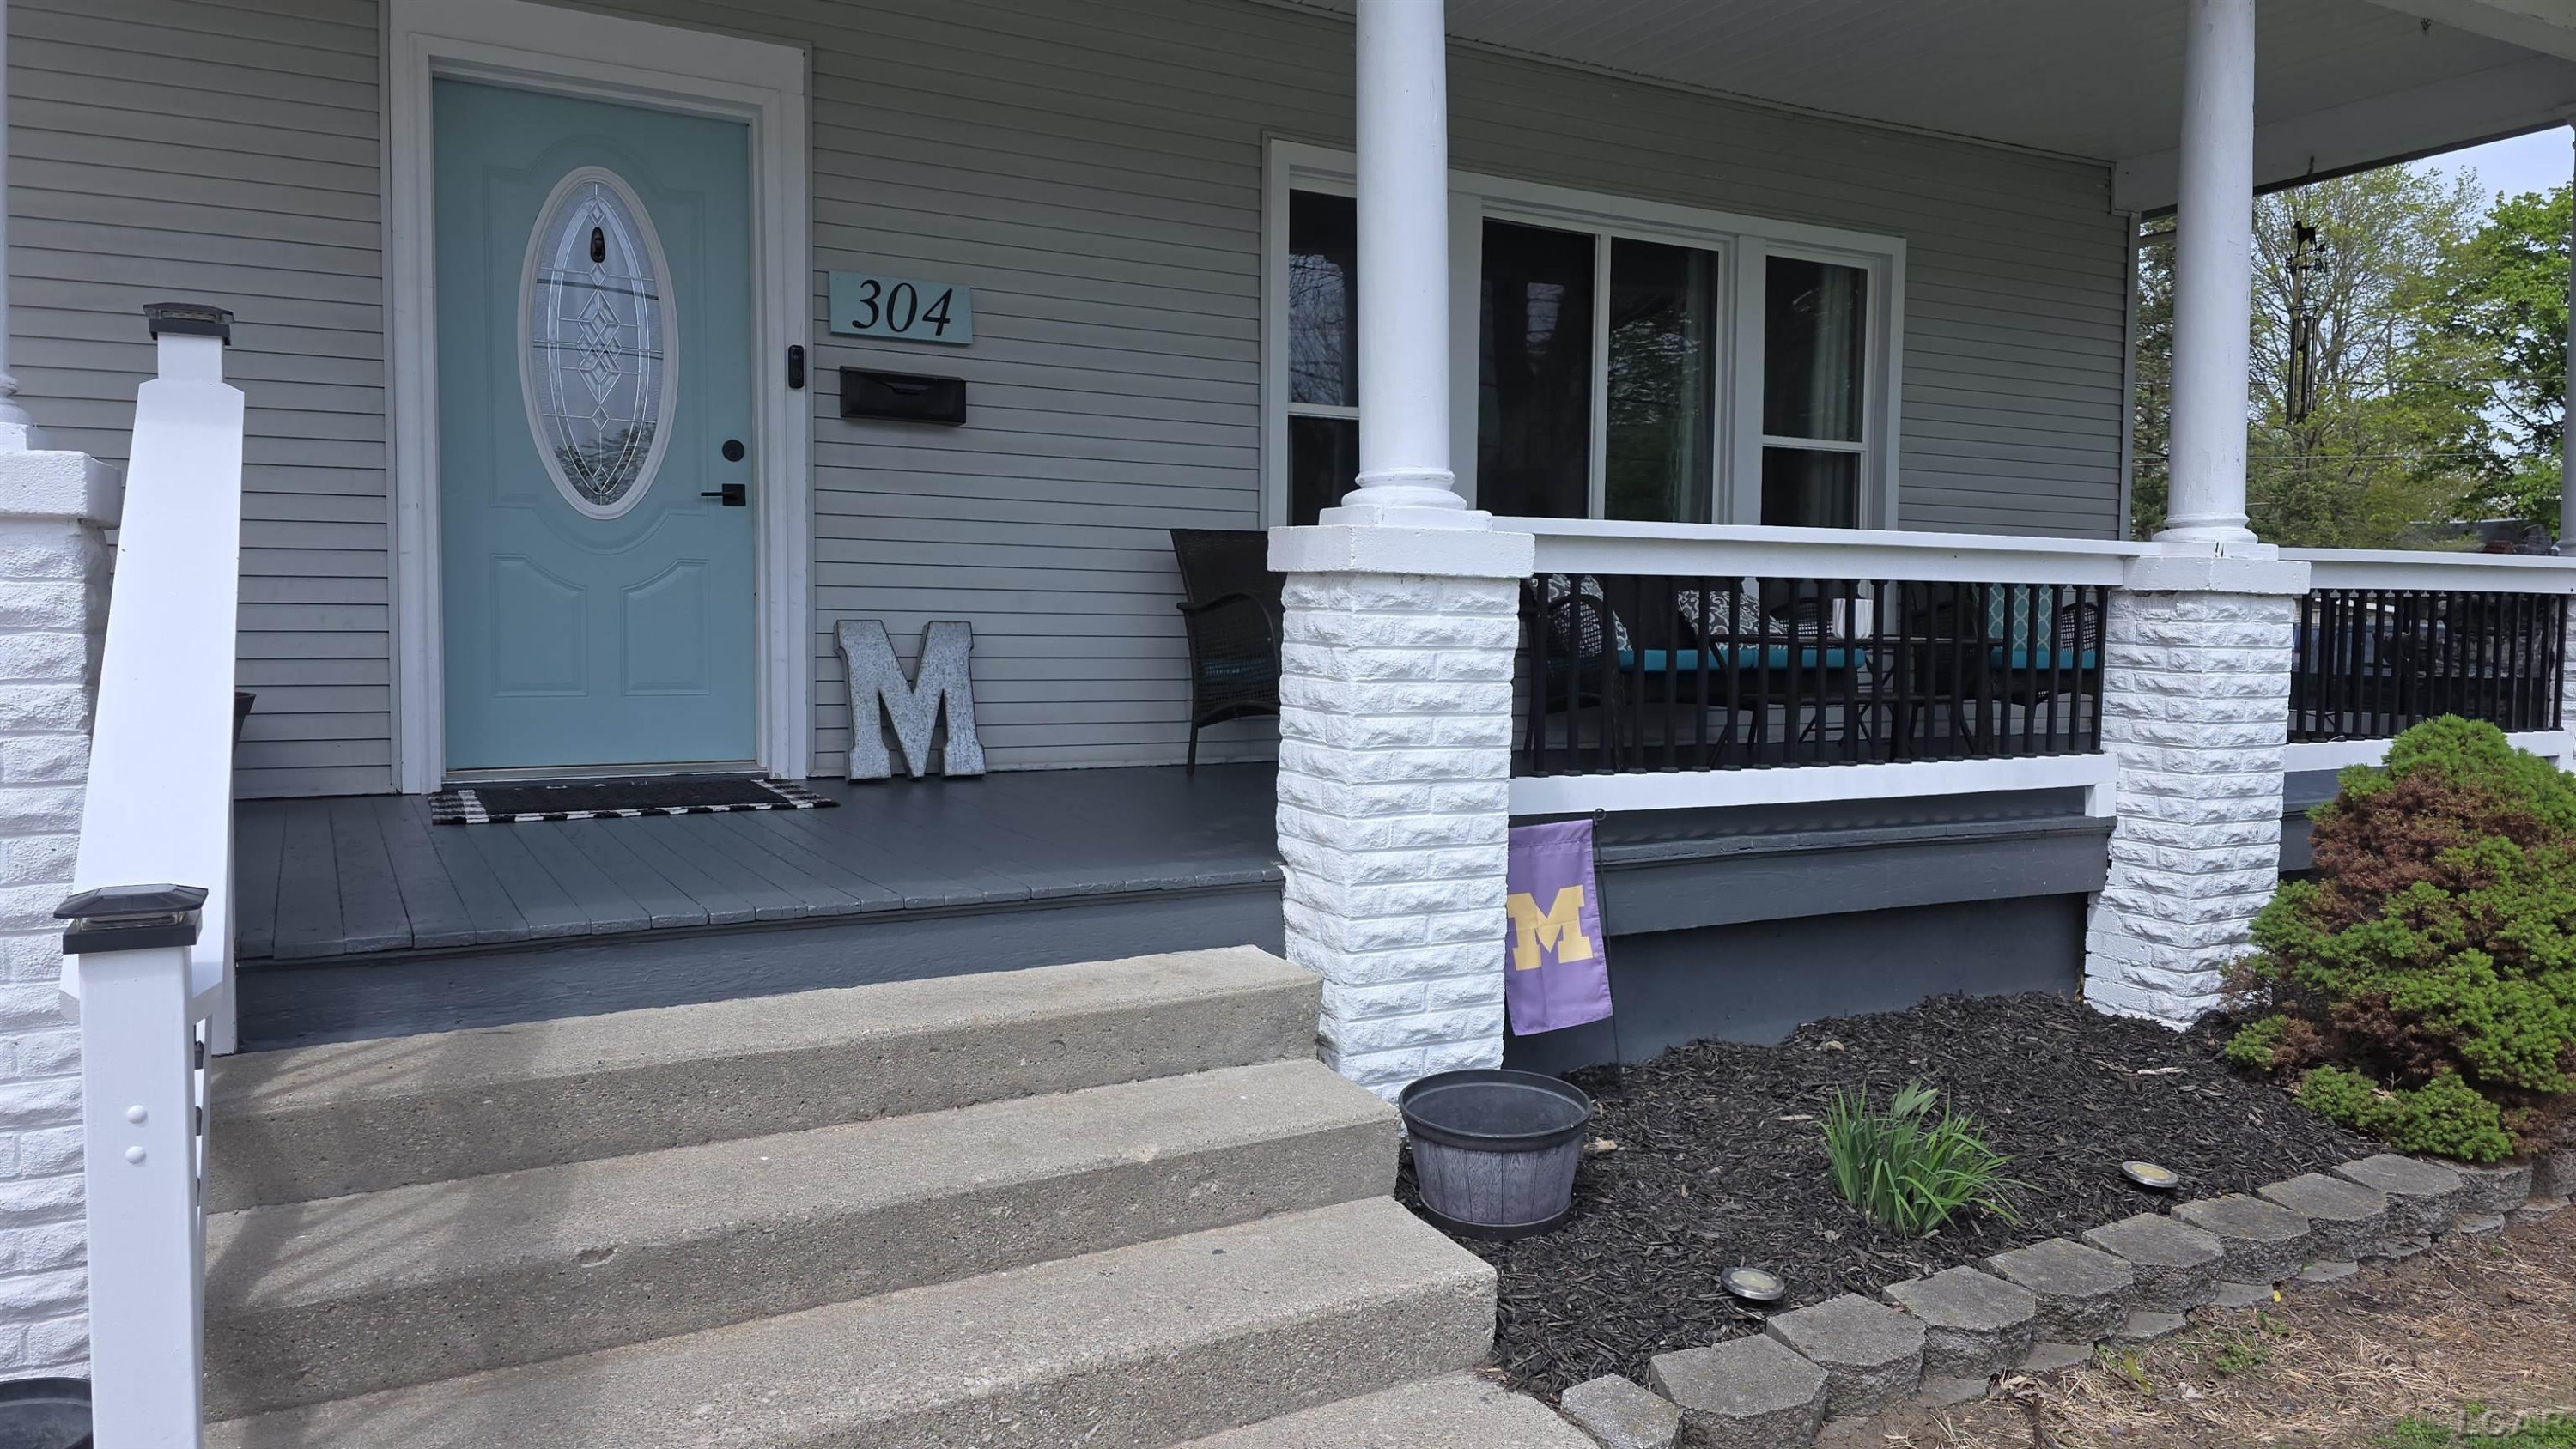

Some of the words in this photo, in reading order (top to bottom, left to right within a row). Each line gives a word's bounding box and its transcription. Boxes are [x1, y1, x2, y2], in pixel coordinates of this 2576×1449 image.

[852, 279, 953, 336] 304
[834, 619, 987, 783] M
[1507, 884, 1594, 971] M
